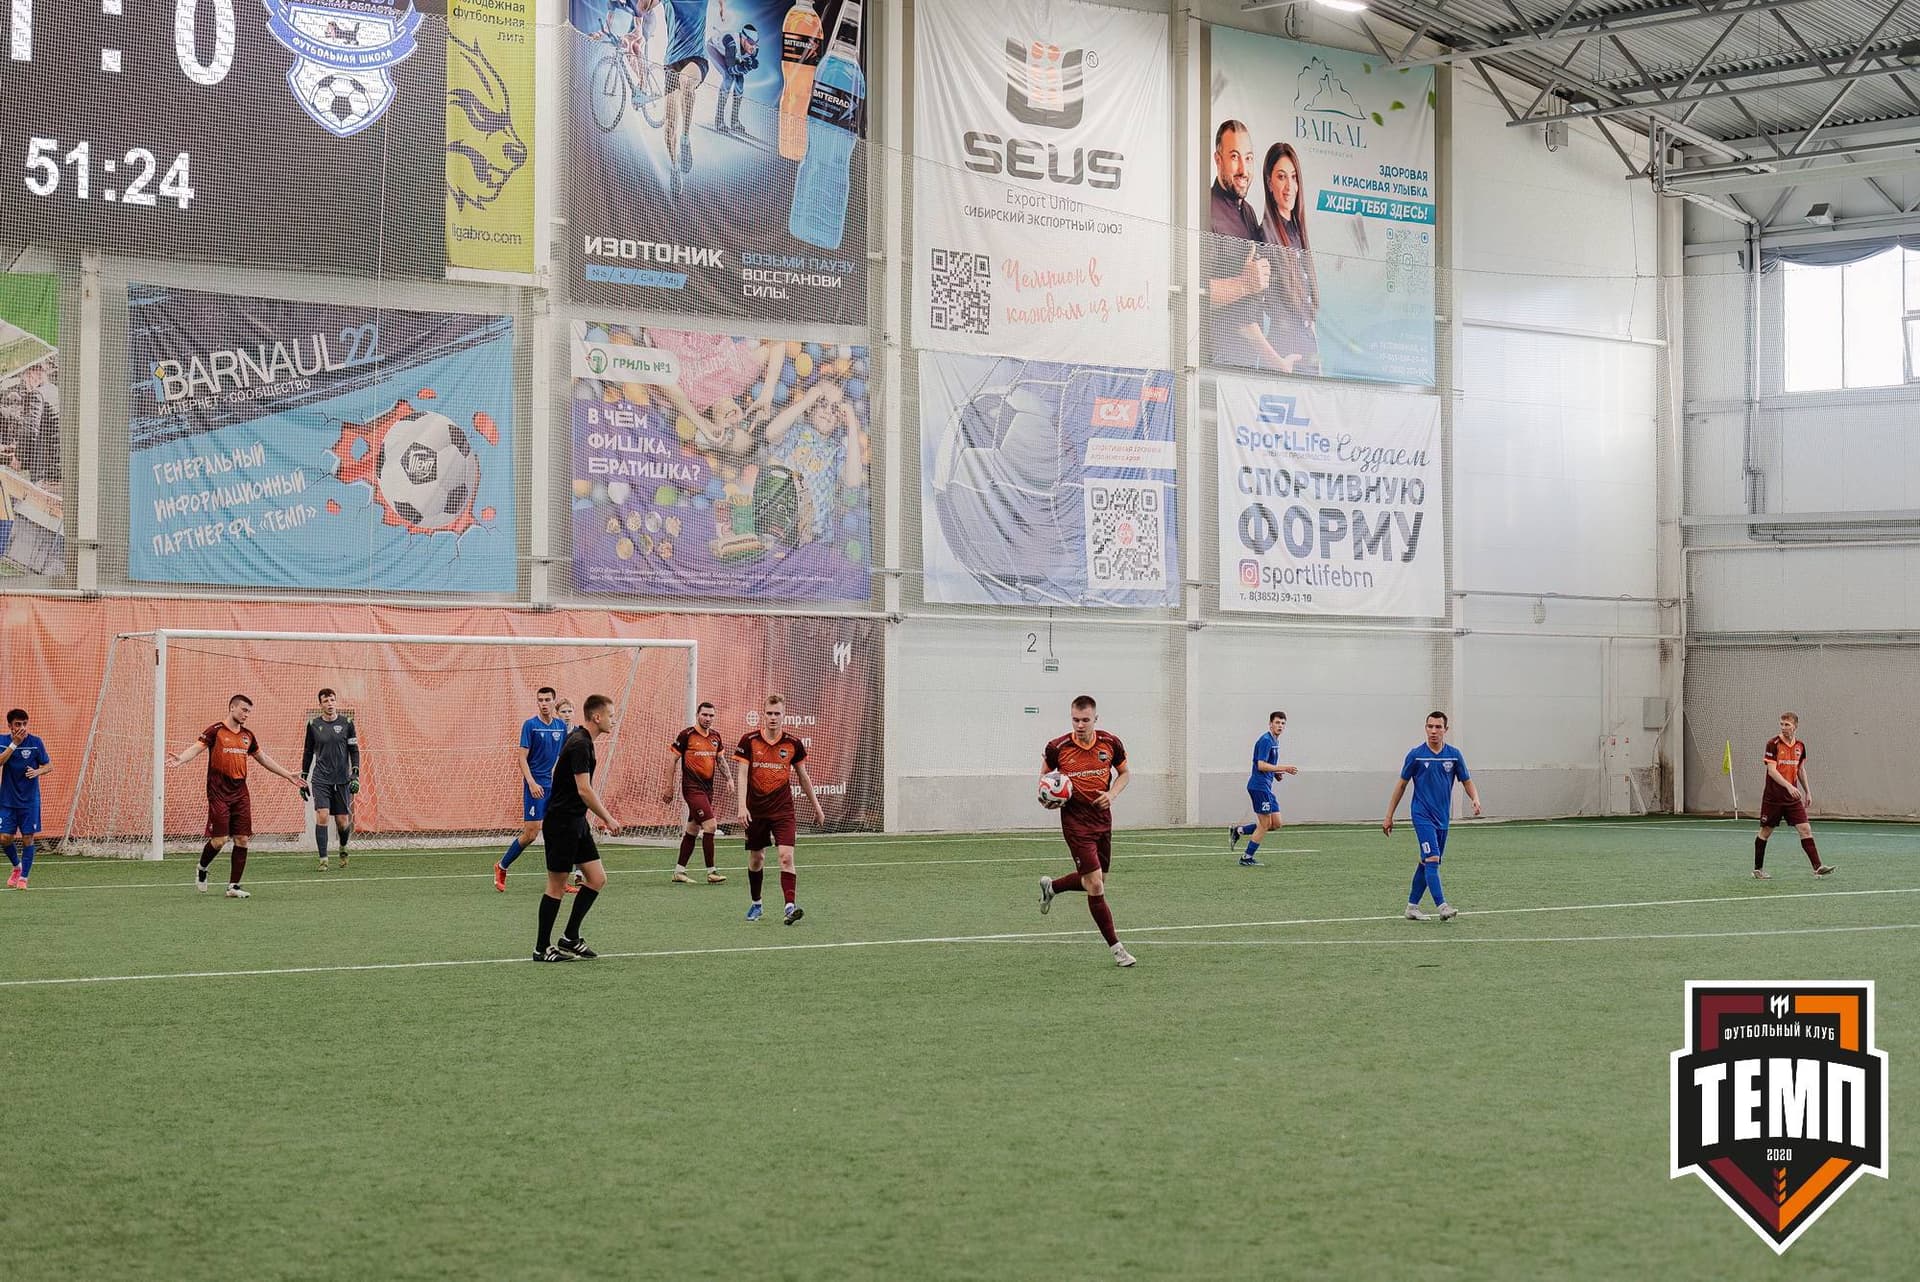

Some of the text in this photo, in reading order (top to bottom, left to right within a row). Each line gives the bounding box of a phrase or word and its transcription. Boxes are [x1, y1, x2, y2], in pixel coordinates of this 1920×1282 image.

[453, 5, 525, 28] футбольная
[292, 37, 393, 64] ФУТБОЛЬНАЯ ШКОЛА
[497, 31, 525, 44] лига
[1295, 116, 1367, 148] BAIKAL
[24, 137, 195, 209] 51:24
[963, 131, 1124, 190] SEUS
[1379, 165, 1428, 181] ЗДОРОВАЯ
[1333, 174, 1428, 198] И КРАСИВАЯ УЛЫБКА
[1006, 189, 1083, 214] Export Union
[1325, 194, 1428, 220] ЖДЕТ ТЕБЯ ЗДЕСЬ!
[964, 205, 1123, 234] СИБИРСКИЙ ЭКСПОРТНЫЙ СОЮЗ
[584, 235, 724, 268] ИЗОТОНИК
[742, 252, 804, 269] ВОЗЬМИ
[743, 268, 841, 288] ВОССТАНОВИ
[743, 285, 789, 300] СИЛЫ.
[1007, 280, 1150, 324] каждом из нас!
[612, 357, 672, 374] ГРИЛЬ №1
[158, 394, 219, 415] ИНТЕРНЕТ
[229, 377, 311, 403] СООБЩЕСТВО
[587, 404, 648, 430] В ЧЁМ
[1256, 394, 1311, 427] SL
[587, 433, 672, 459] ФИШКА,
[1236, 426, 1330, 453] SportLife
[152, 440, 266, 486] ГЕНЕРАЛЬНЫЙ
[1337, 433, 1431, 473] Создаем
[588, 457, 701, 481] БРАТИШКА?
[153, 467, 306, 523] ИНФОРМАЦИОННЫЙ
[1238, 465, 1425, 506] СПОРТИВНУЮ
[152, 504, 318, 557] ПАРТНЕР ФК «ТЕМП»
[1237, 502, 1424, 564] ФОРМУ
[1262, 563, 1374, 589] sportlifebrn
[1027, 632, 1037, 652] 2
[529, 806, 535, 817] 4
